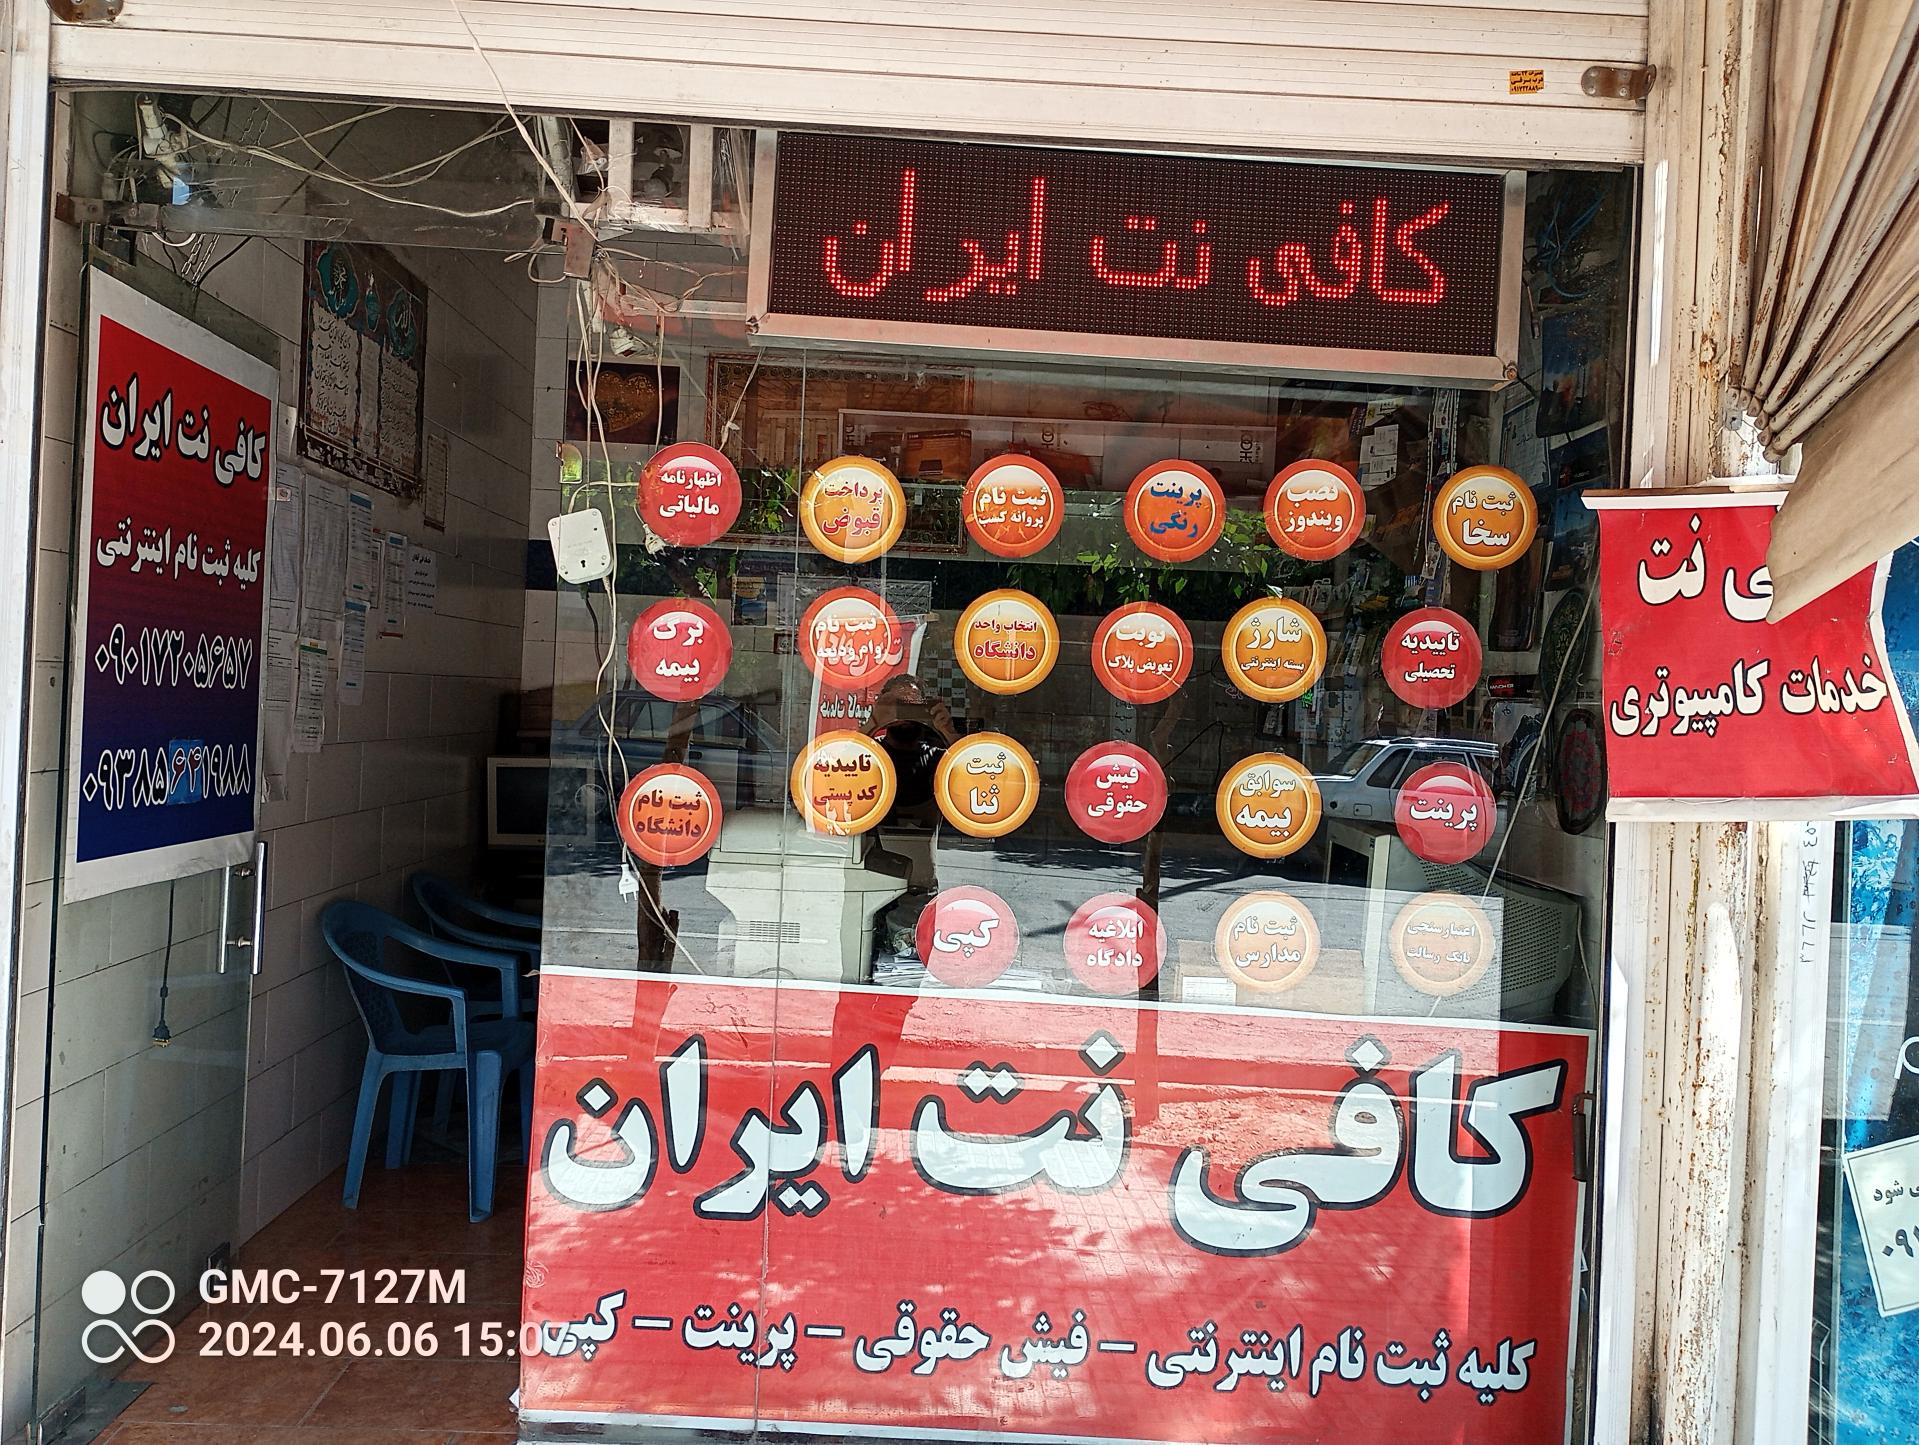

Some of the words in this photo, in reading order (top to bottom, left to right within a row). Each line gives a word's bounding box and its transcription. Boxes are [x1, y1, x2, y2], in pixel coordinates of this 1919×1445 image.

[821, 166, 1047, 302] ایران
[1091, 215, 1211, 291] نت
[1248, 198, 1450, 306] کافی
[101, 372, 173, 461] ایران
[176, 407, 211, 460] نت
[214, 419, 266, 486] کافی
[659, 470, 722, 490] اظهارنامه
[822, 480, 884, 507] پرداخت
[1286, 479, 1339, 506] نصب
[658, 494, 720, 518] مالیاتی
[979, 485, 1007, 512] نام
[1011, 485, 1048, 510] ثبت
[1150, 481, 1202, 508] پرینت
[1451, 490, 1477, 513] نام
[1481, 491, 1517, 516] ثبت
[821, 508, 882, 537] قبوض
[977, 510, 1007, 526] کسب
[1010, 511, 1044, 529] پروانه
[1150, 509, 1198, 538] رنگی
[1285, 509, 1343, 533] ویندوز
[96, 517, 172, 573] اینترنتی
[1461, 518, 1511, 547] سخا
[174, 532, 198, 580] نام
[202, 539, 231, 586] ثبت
[232, 548, 261, 590] کلیه
[1637, 513, 1707, 606] نت
[652, 618, 705, 647] برگ
[814, 614, 840, 641] نام
[844, 611, 877, 636] ثبت
[974, 618, 1001, 633] واحد
[1003, 619, 1037, 633] انتخاب
[1115, 624, 1166, 650] نوبت
[1246, 616, 1303, 650] شارژ
[95, 623, 253, 690] ۰۹۰۱۷۲۰۵۶۵۷
[974, 640, 1036, 660] دانشگاه
[1401, 631, 1460, 656] تاییدیه
[655, 657, 701, 683] بیمه
[1108, 655, 1134, 673] پلاک
[1136, 659, 1174, 675] تعویض
[1240, 655, 1281, 672] اینترنتی
[1282, 658, 1305, 673] بسته
[1404, 662, 1456, 683] تحصیلی
[1610, 657, 1770, 737] کامپیوتری
[1780, 654, 1889, 715] خدمات
[83, 743, 251, 811] ۰۹۳۸۵۶۴۱۹۸۸
[813, 752, 872, 778] تاییدیه
[966, 752, 1006, 780] ثبت
[1095, 761, 1140, 789] فیش
[813, 788, 853, 807] پستی
[857, 784, 878, 801] کد
[1238, 769, 1297, 798] سوابق
[637, 788, 664, 812] نام
[668, 791, 702, 816] ثبت
[969, 784, 1000, 815] ثنا
[1087, 791, 1148, 819] حقوقی
[636, 816, 702, 838] دانشگاه
[1234, 804, 1293, 838] بیمه
[1409, 797, 1478, 832] پرینت
[932, 917, 1000, 959] کپی
[1088, 918, 1144, 945] ابلاغیه
[1233, 915, 1260, 940] نام
[1264, 915, 1297, 939] ثبت
[1086, 948, 1143, 968] دادگاه
[1236, 943, 1301, 968] مدارس
[1407, 946, 1441, 965] رسالت
[541, 1033, 881, 1220] ایران
[911, 1028, 1131, 1197] نت
[1169, 1033, 1568, 1258] کافی
[1873, 1179, 1904, 1206] شود
[541, 1288, 627, 1362] کپی
[682, 1302, 797, 1372] پرینت
[854, 1301, 992, 1377] حقوقی
[1001, 1309, 1091, 1381] فیش
[1146, 1319, 1304, 1393] اینترنتی
[1309, 1324, 1368, 1397] نام
[1375, 1328, 1451, 1401] ثبت
[1456, 1338, 1537, 1406] کلیه
